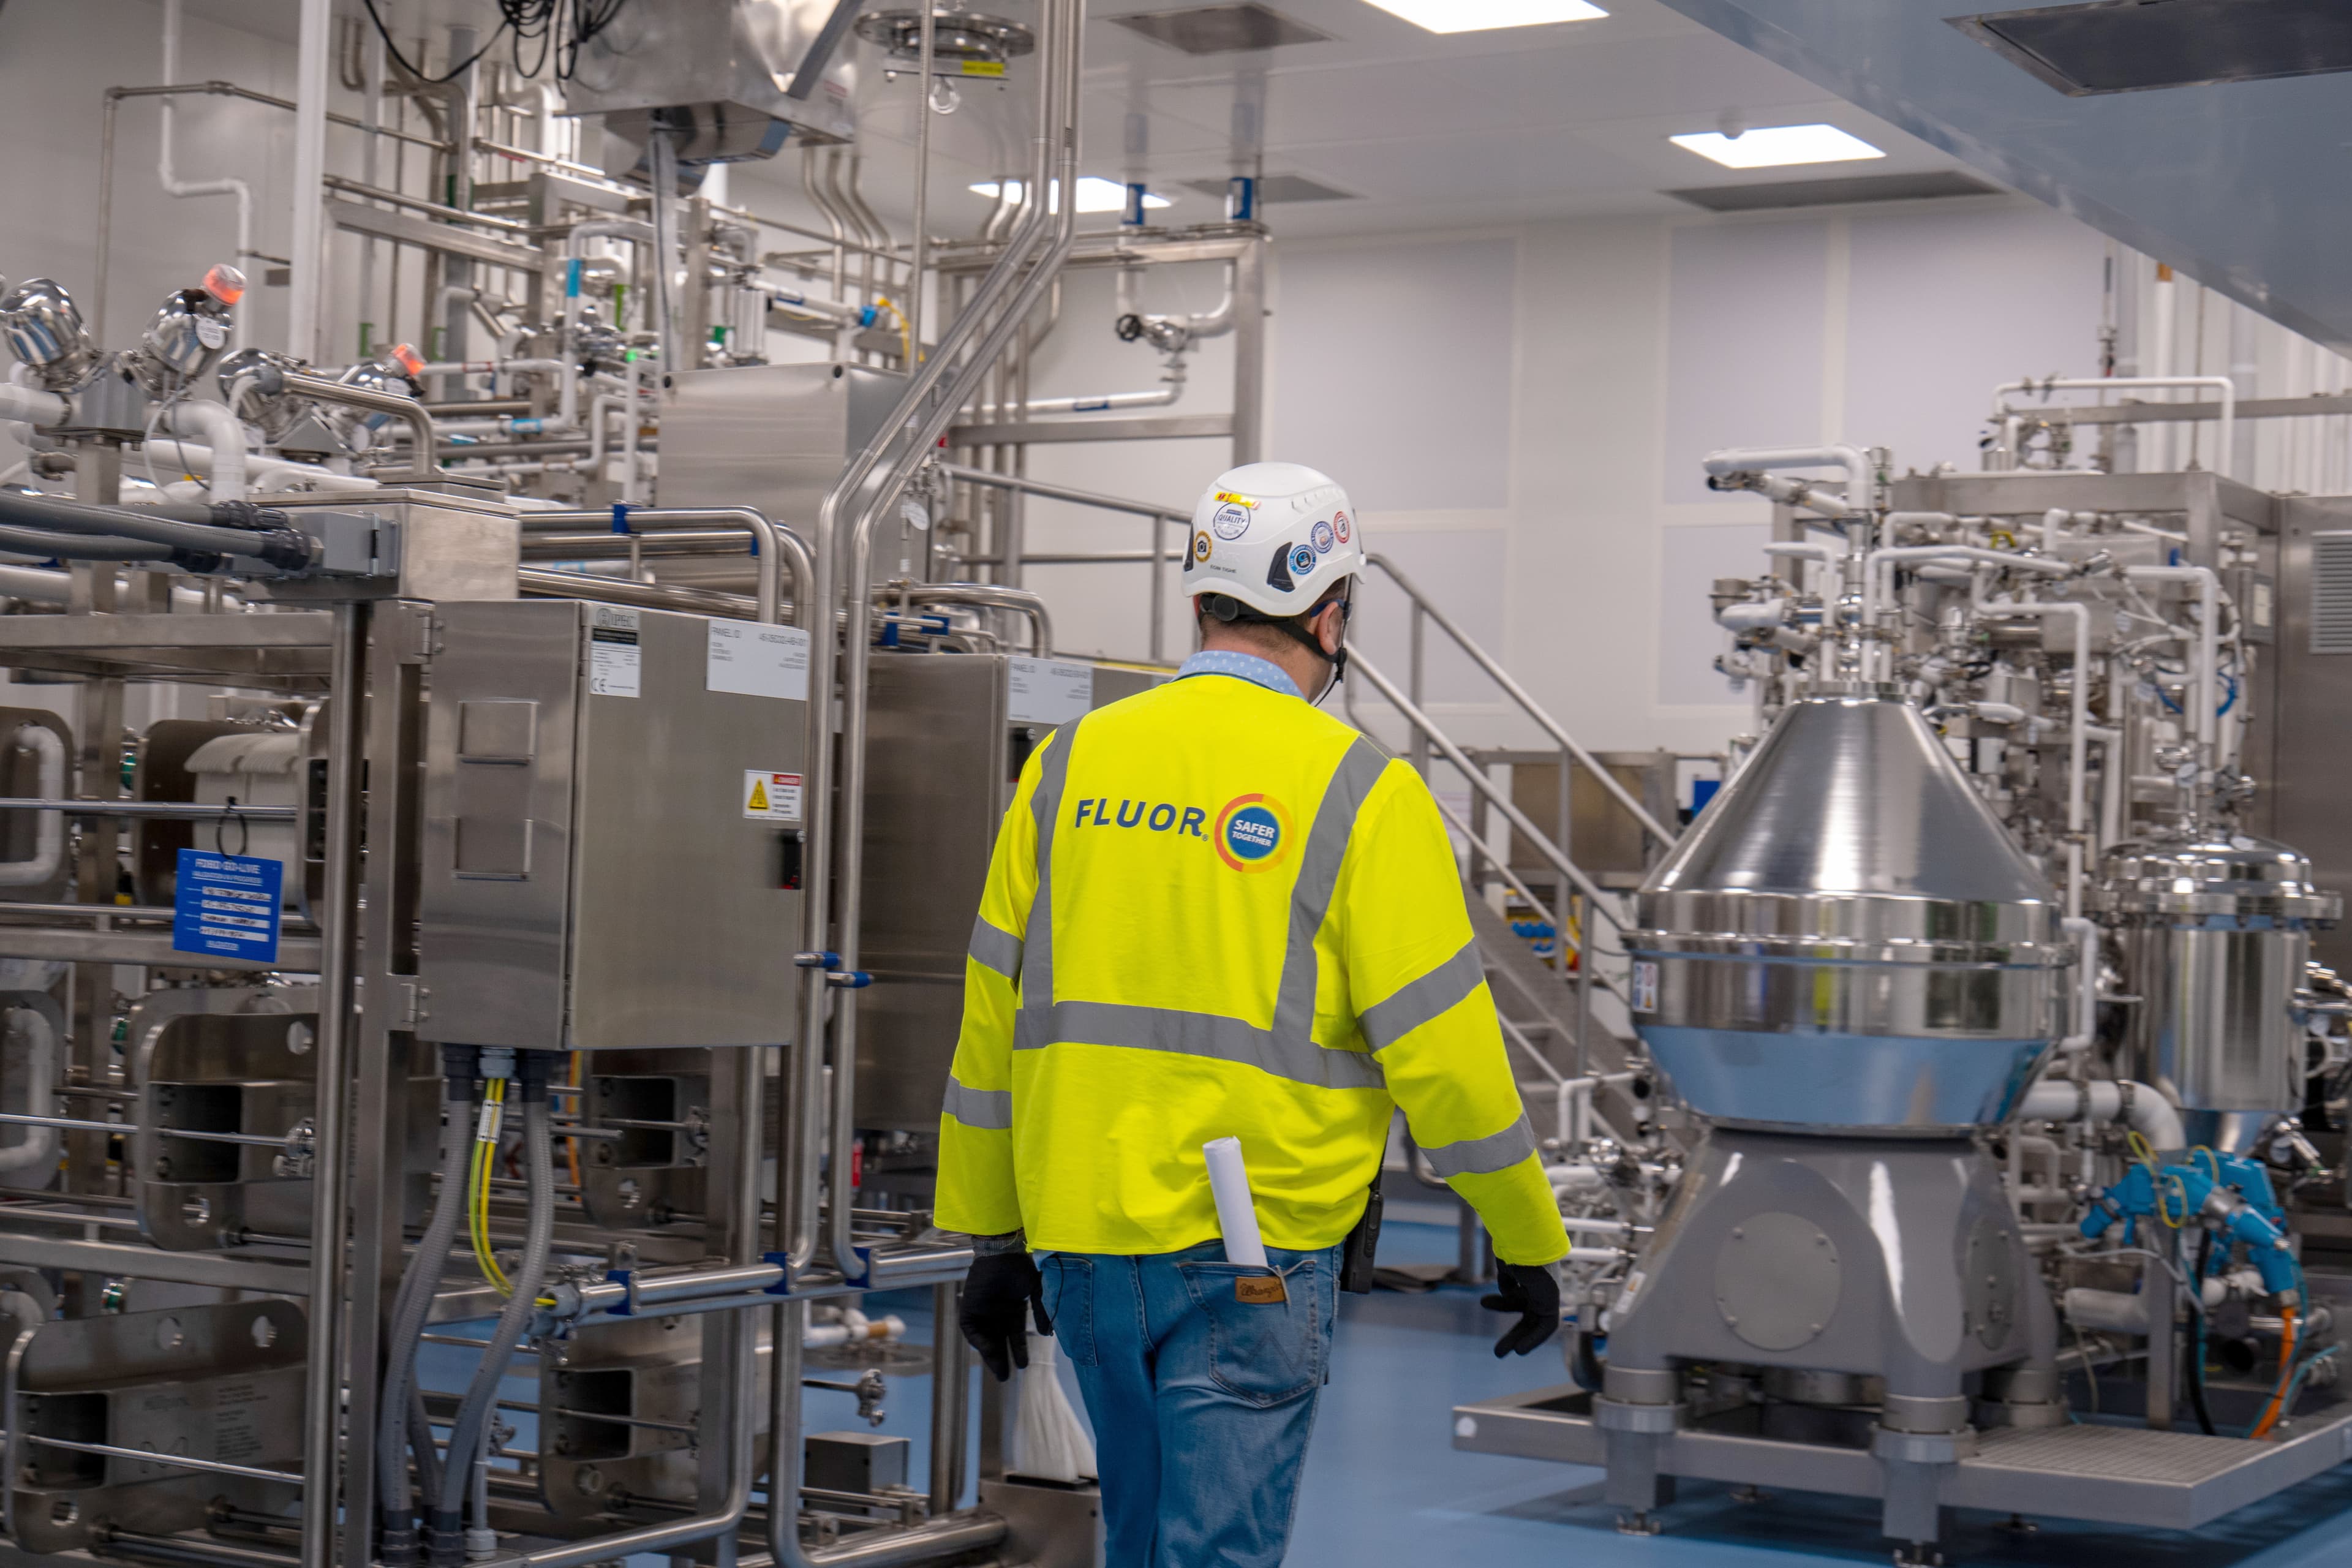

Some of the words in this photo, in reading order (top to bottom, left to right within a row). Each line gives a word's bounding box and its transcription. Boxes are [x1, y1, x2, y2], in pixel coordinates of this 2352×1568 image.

[1218, 514, 1246, 524] QUALITY
[1075, 797, 1206, 837] FLUOR
[1233, 819, 1276, 839] SAFER
[1232, 831, 1272, 847] TOGETHER
